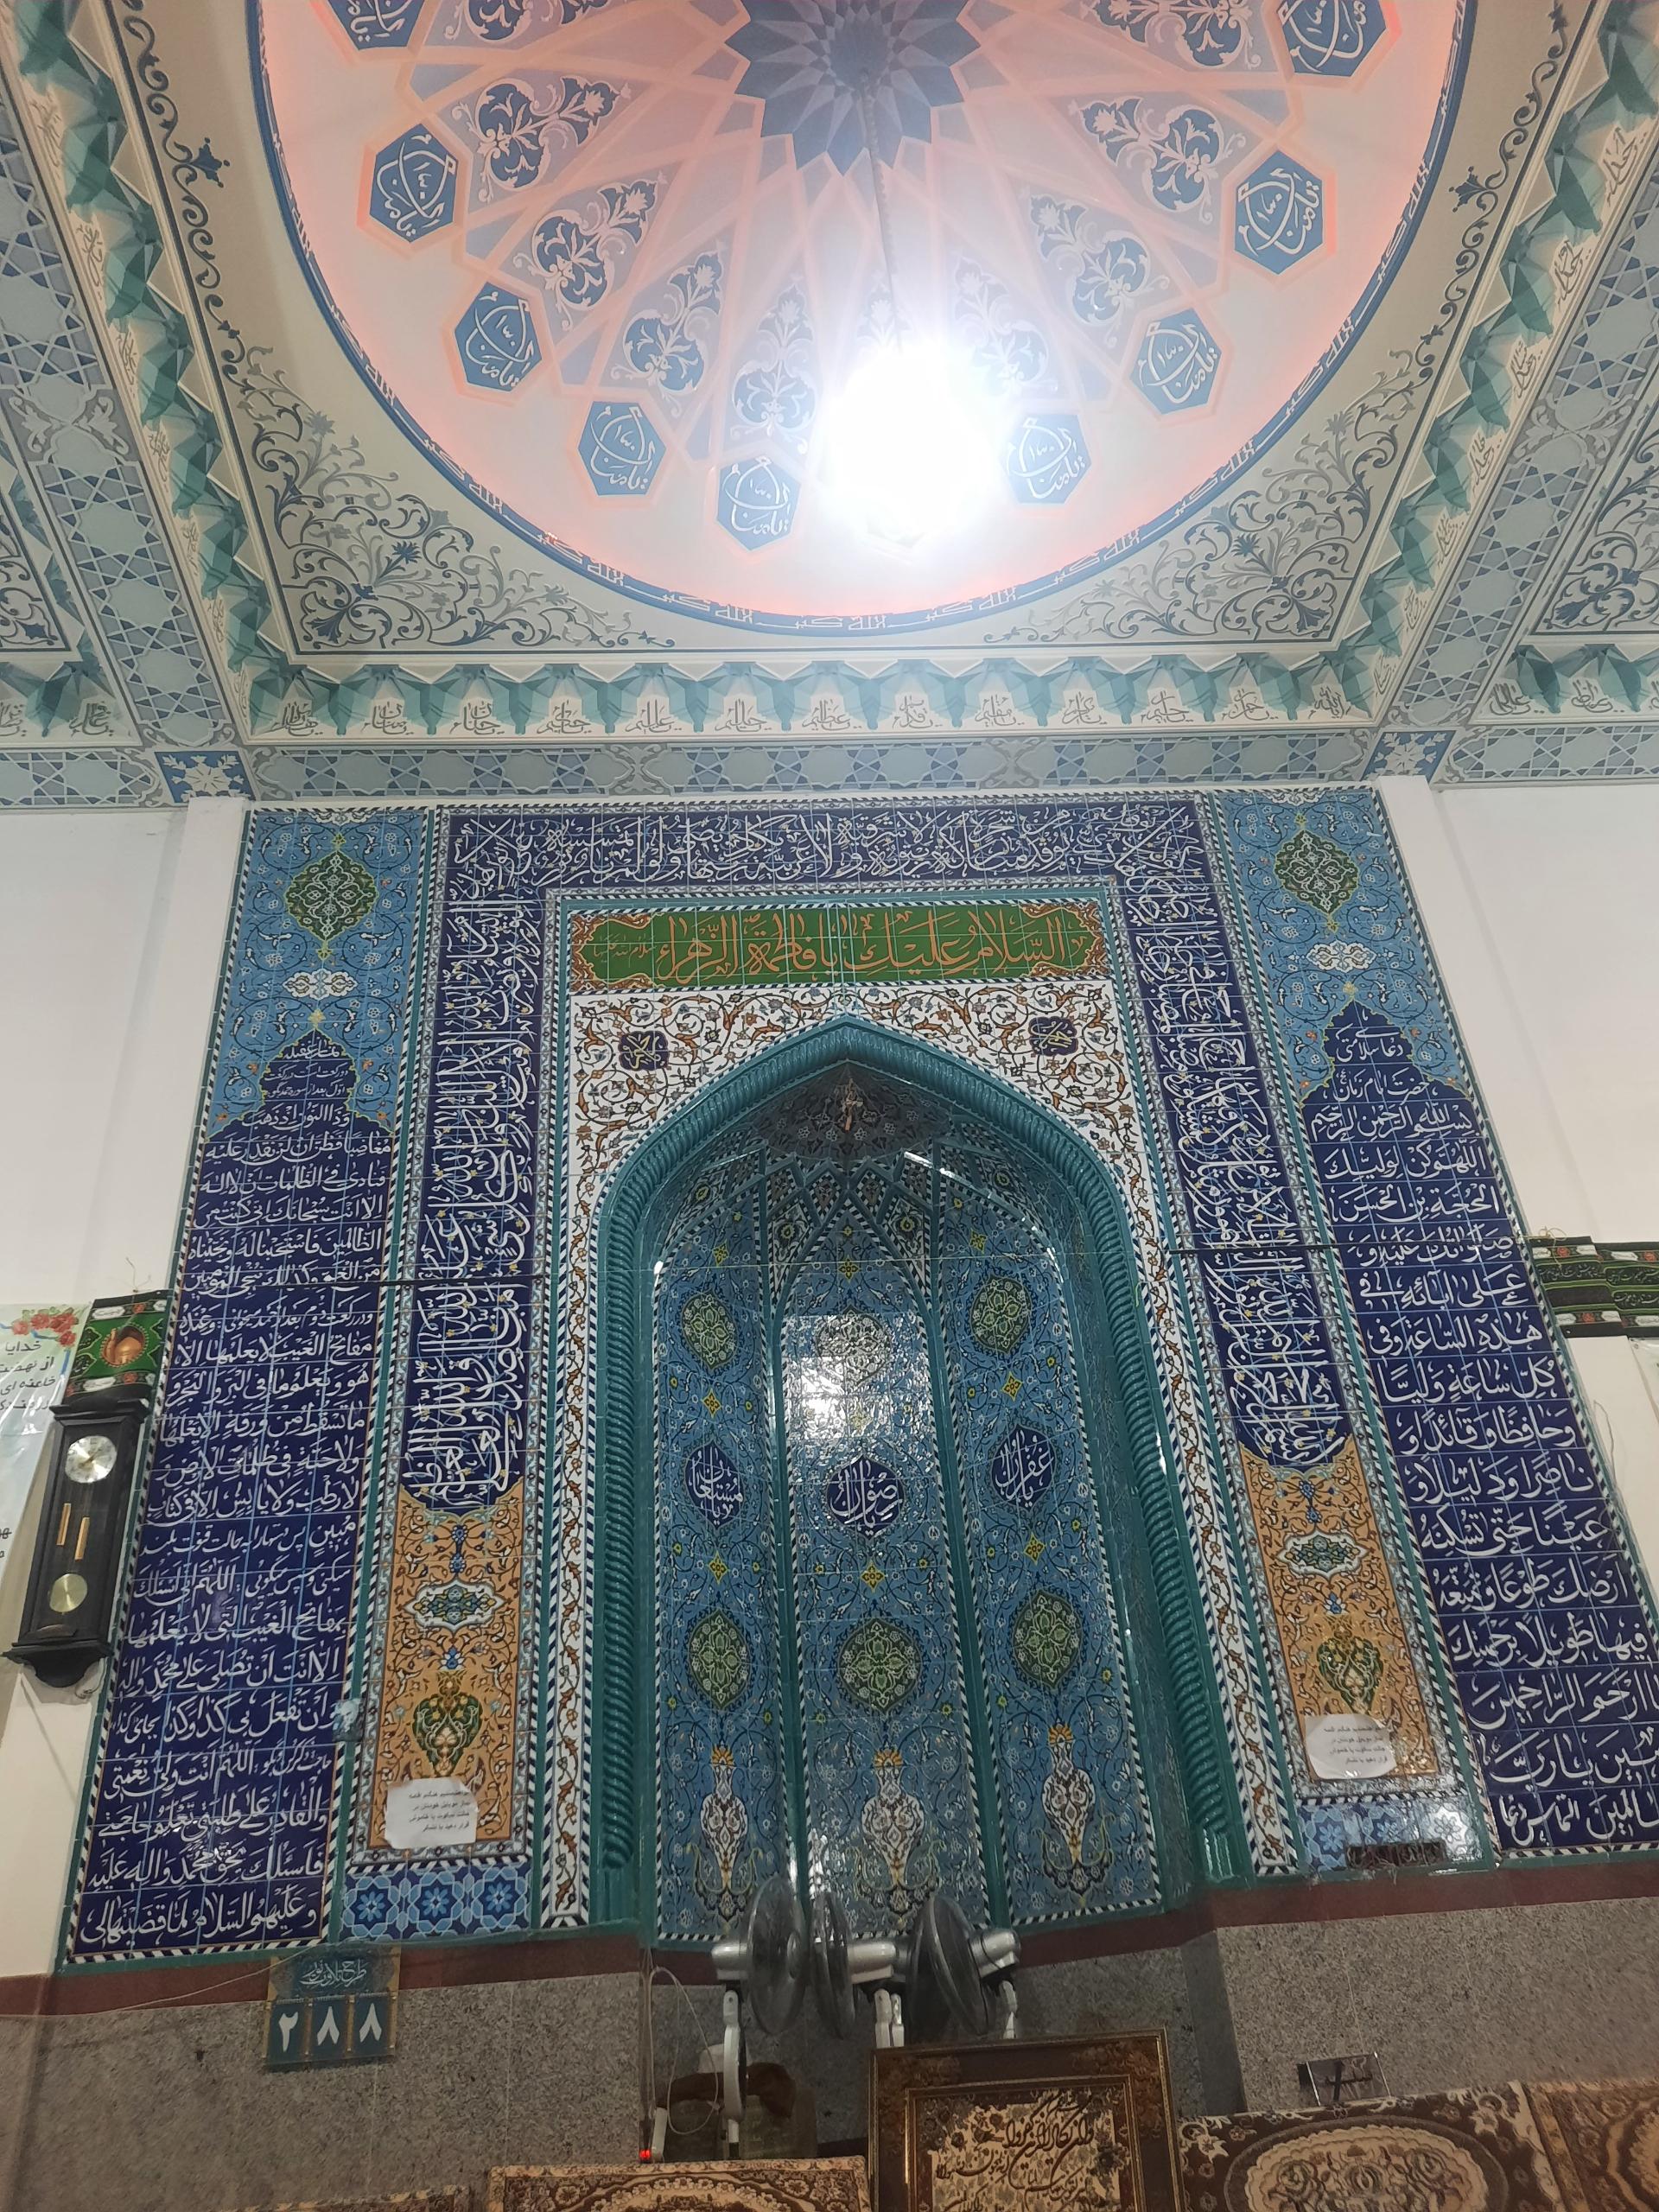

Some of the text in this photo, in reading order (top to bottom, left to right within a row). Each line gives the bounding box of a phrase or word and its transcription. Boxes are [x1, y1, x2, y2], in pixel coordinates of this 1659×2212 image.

[656, 913, 740, 984] الزهراء
[819, 912, 839, 976] یا
[938, 909, 1065, 976] السلام
[1336, 1038, 1379, 1062] سلامتی
[1387, 1077, 1429, 1105] حضرت
[1419, 1102, 1451, 1124] الله
[1311, 1105, 1357, 1141] الرحیم
[1357, 1105, 1414, 1141] الرحمن
[5, 1340, 41, 1355] خدایا
[40, 1356, 54, 1370] از
[1529, 1507, 1606, 1551] عینا
[1491, 1558, 1549, 1609] طوعا
[1516, 1612, 1594, 1668] طویلا
[1588, 1614, 1649, 1662] فیها
[1467, 1673, 1586, 1730] الراحمین
[1490, 1734, 1592, 1793] یا رب
[343, 1959, 368, 1986] طرح
